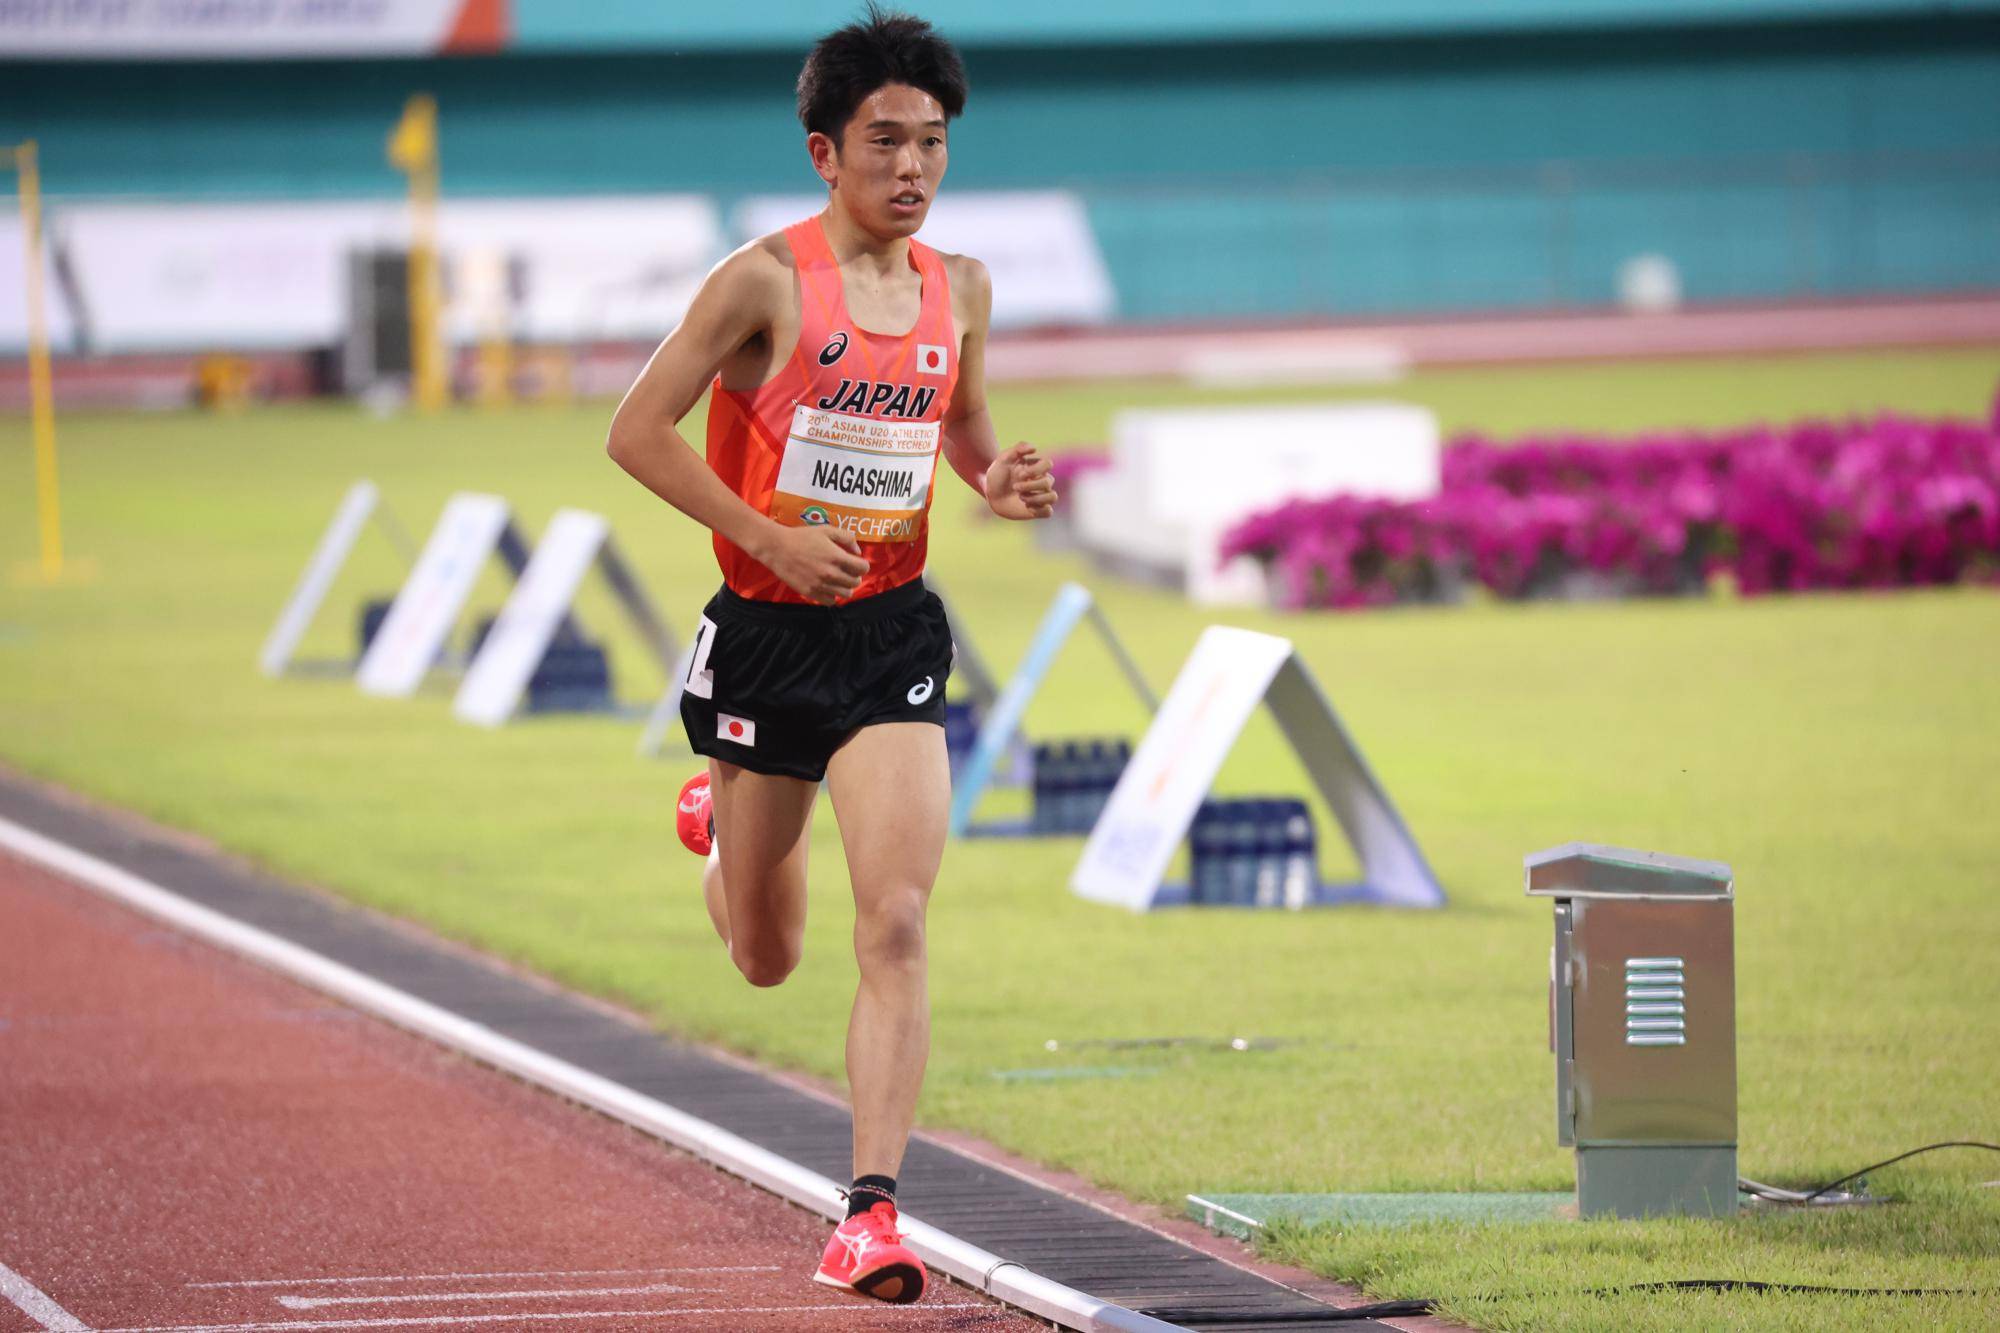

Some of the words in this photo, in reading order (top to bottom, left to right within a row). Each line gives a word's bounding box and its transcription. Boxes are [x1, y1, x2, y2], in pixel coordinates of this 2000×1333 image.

[819, 379, 937, 418] JAPAN
[807, 415, 830, 426] 20th
[832, 420, 866, 434] ASIAN
[870, 427, 889, 437] U20
[807, 426, 893, 449] CHAMPIONSHIPS
[897, 440, 931, 450] YECHEON
[811, 459, 914, 498] NAGASHIMA
[836, 513, 913, 536] YECHEON
